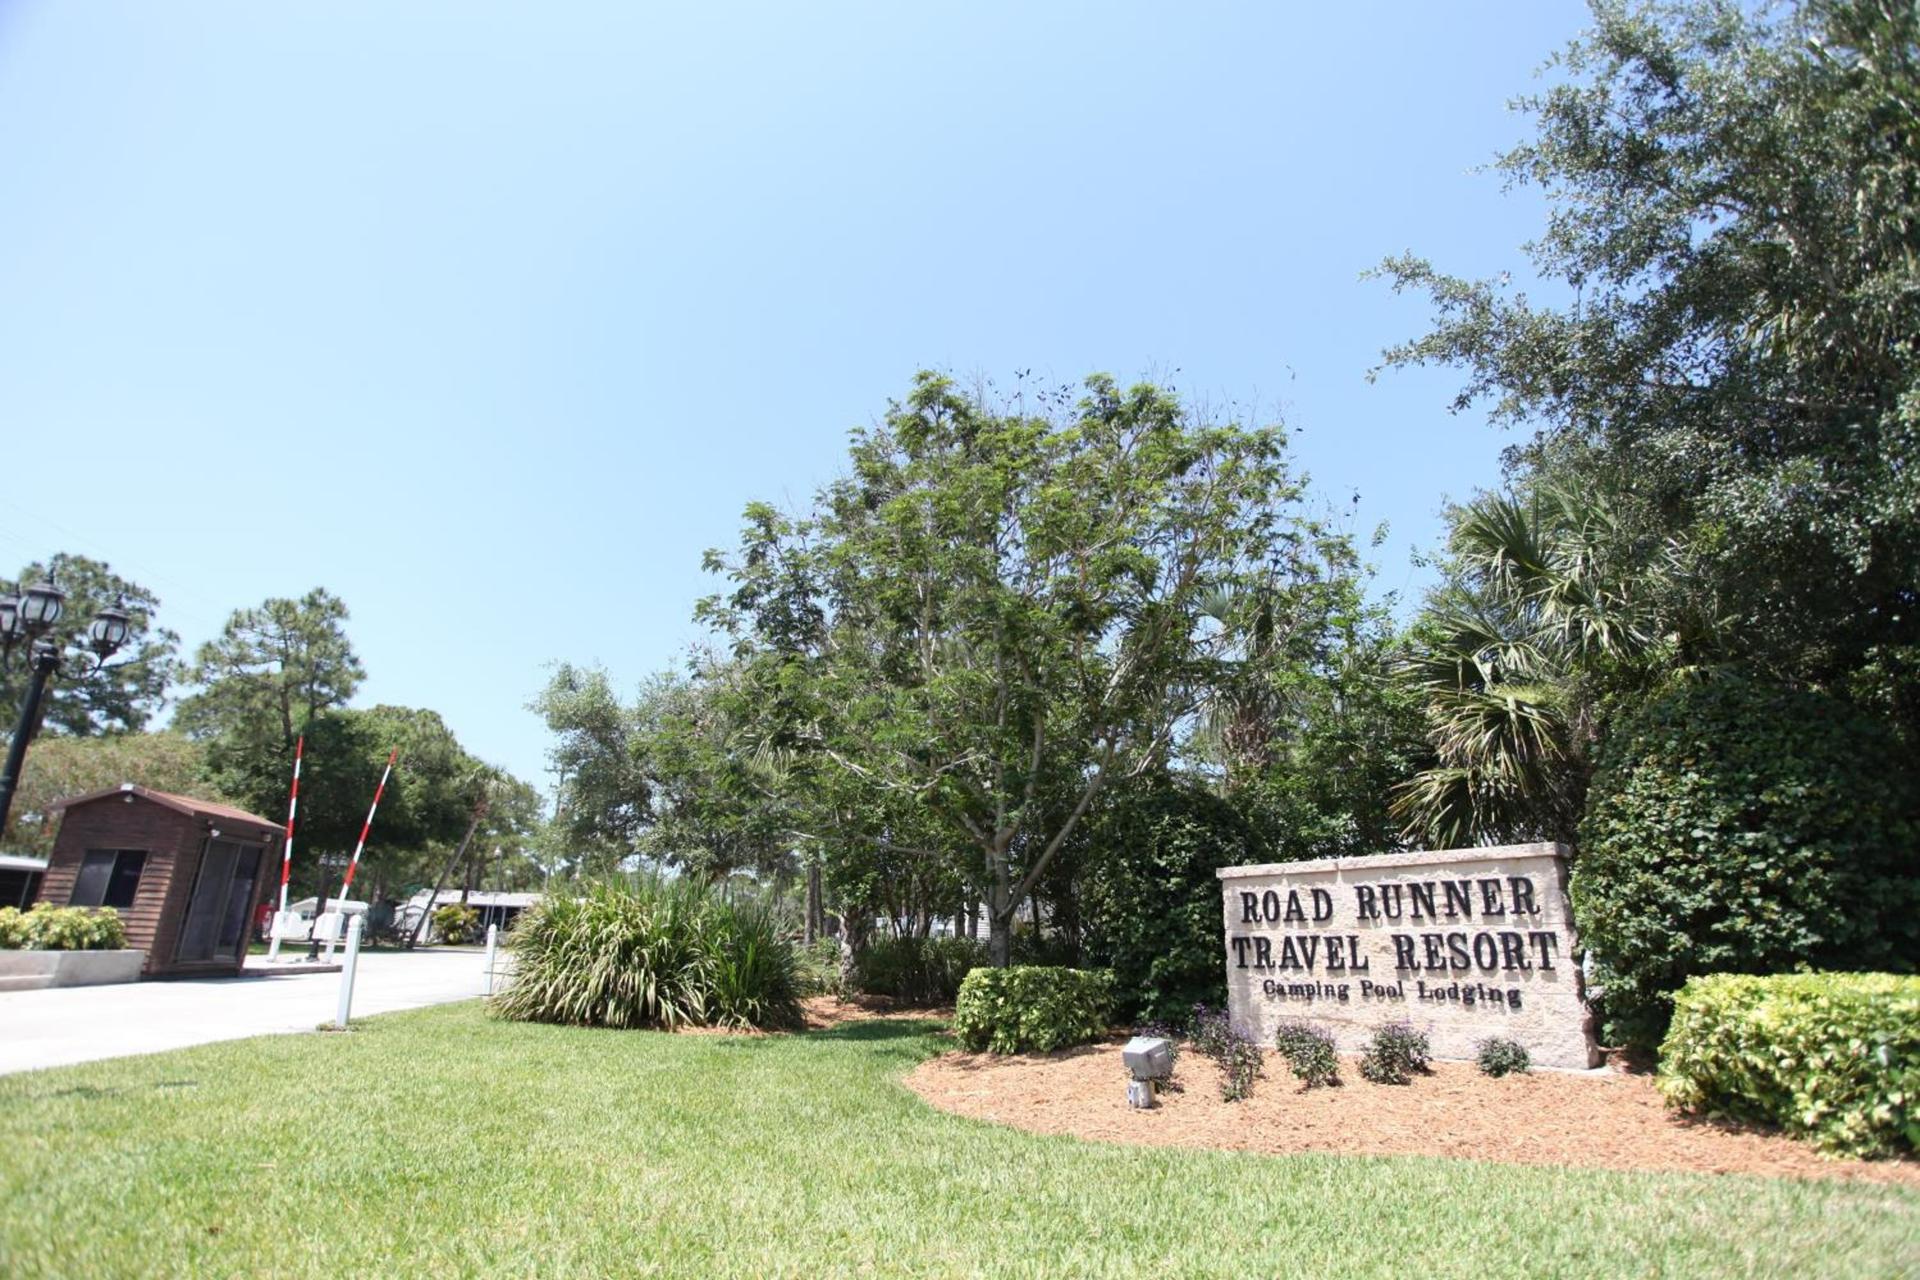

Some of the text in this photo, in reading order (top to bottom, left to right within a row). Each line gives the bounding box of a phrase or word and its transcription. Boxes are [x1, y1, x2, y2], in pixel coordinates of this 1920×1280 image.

[1239, 876, 1541, 923] ROAD RUNNER
[1232, 931, 1558, 972] TRAVEL RESORT
[1263, 979, 1522, 1008] Camping Pool Lodging
